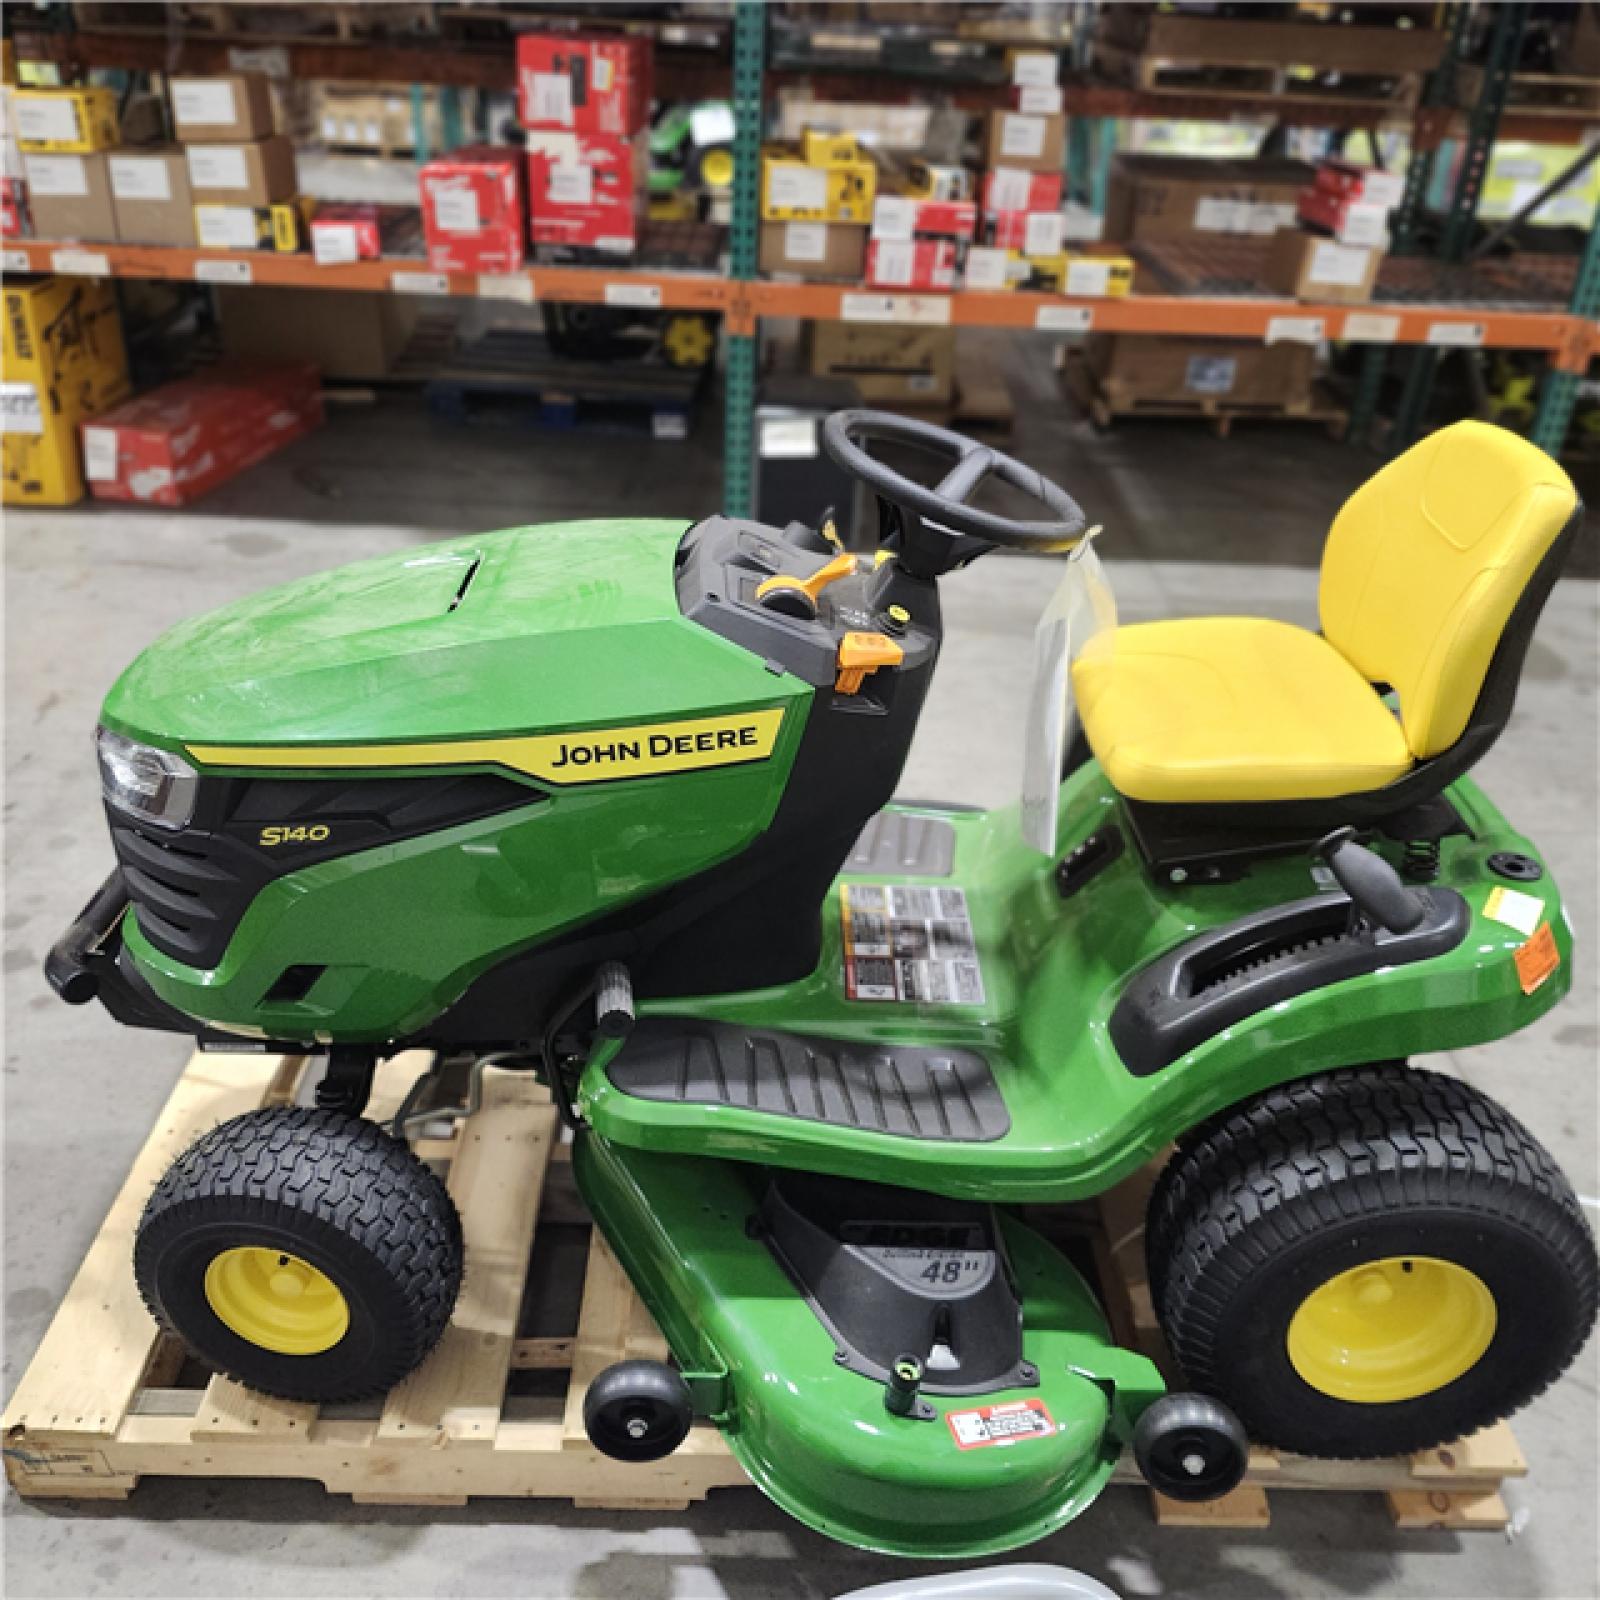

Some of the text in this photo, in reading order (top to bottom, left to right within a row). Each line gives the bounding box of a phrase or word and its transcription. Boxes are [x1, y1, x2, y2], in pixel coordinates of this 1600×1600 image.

[551, 726, 759, 768] JOHN DEERE
[259, 824, 331, 846] S140
[920, 1259, 979, 1284] 48"
